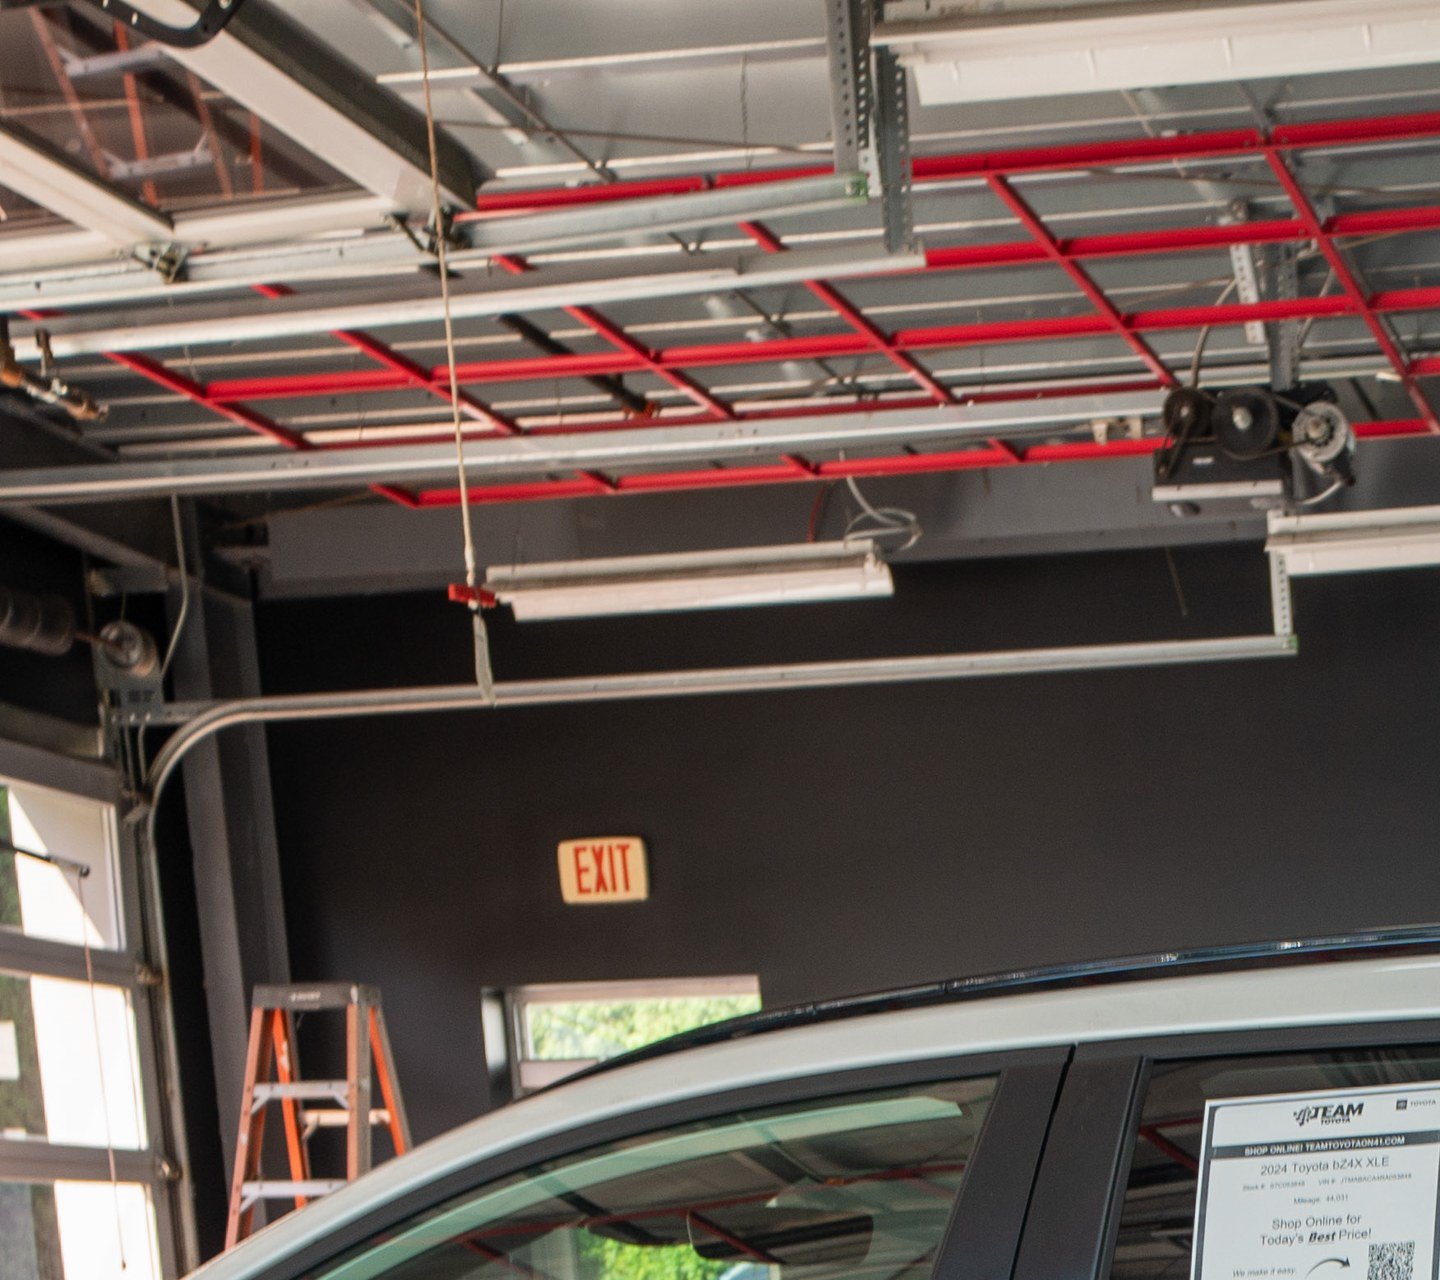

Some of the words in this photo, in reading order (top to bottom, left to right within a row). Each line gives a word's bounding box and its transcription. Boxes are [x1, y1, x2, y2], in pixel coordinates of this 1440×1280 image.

[573, 844, 631, 895] EXIT
[1310, 1103, 1364, 1119] TEAM
[1410, 1099, 1437, 1107] TOYOTA
[1321, 1117, 1351, 1125] TOYOTA
[1244, 1146, 1268, 1156] SHOP
[1270, 1143, 1303, 1154] ONLINE!
[1260, 1164, 1288, 1176] 2024
[1292, 1162, 1329, 1175] Toyota
[1332, 1158, 1363, 1170] bZ4X
[1366, 1156, 1390, 1168] XLE
[1272, 1218, 1302, 1231] Shop
[1305, 1216, 1342, 1228] Online
[1346, 1215, 1361, 1225] for
[1260, 1233, 1304, 1247] Today's
[1308, 1231, 1336, 1243] Best
[1338, 1228, 1372, 1241] Price!
[1247, 1268, 1270, 1277] make
